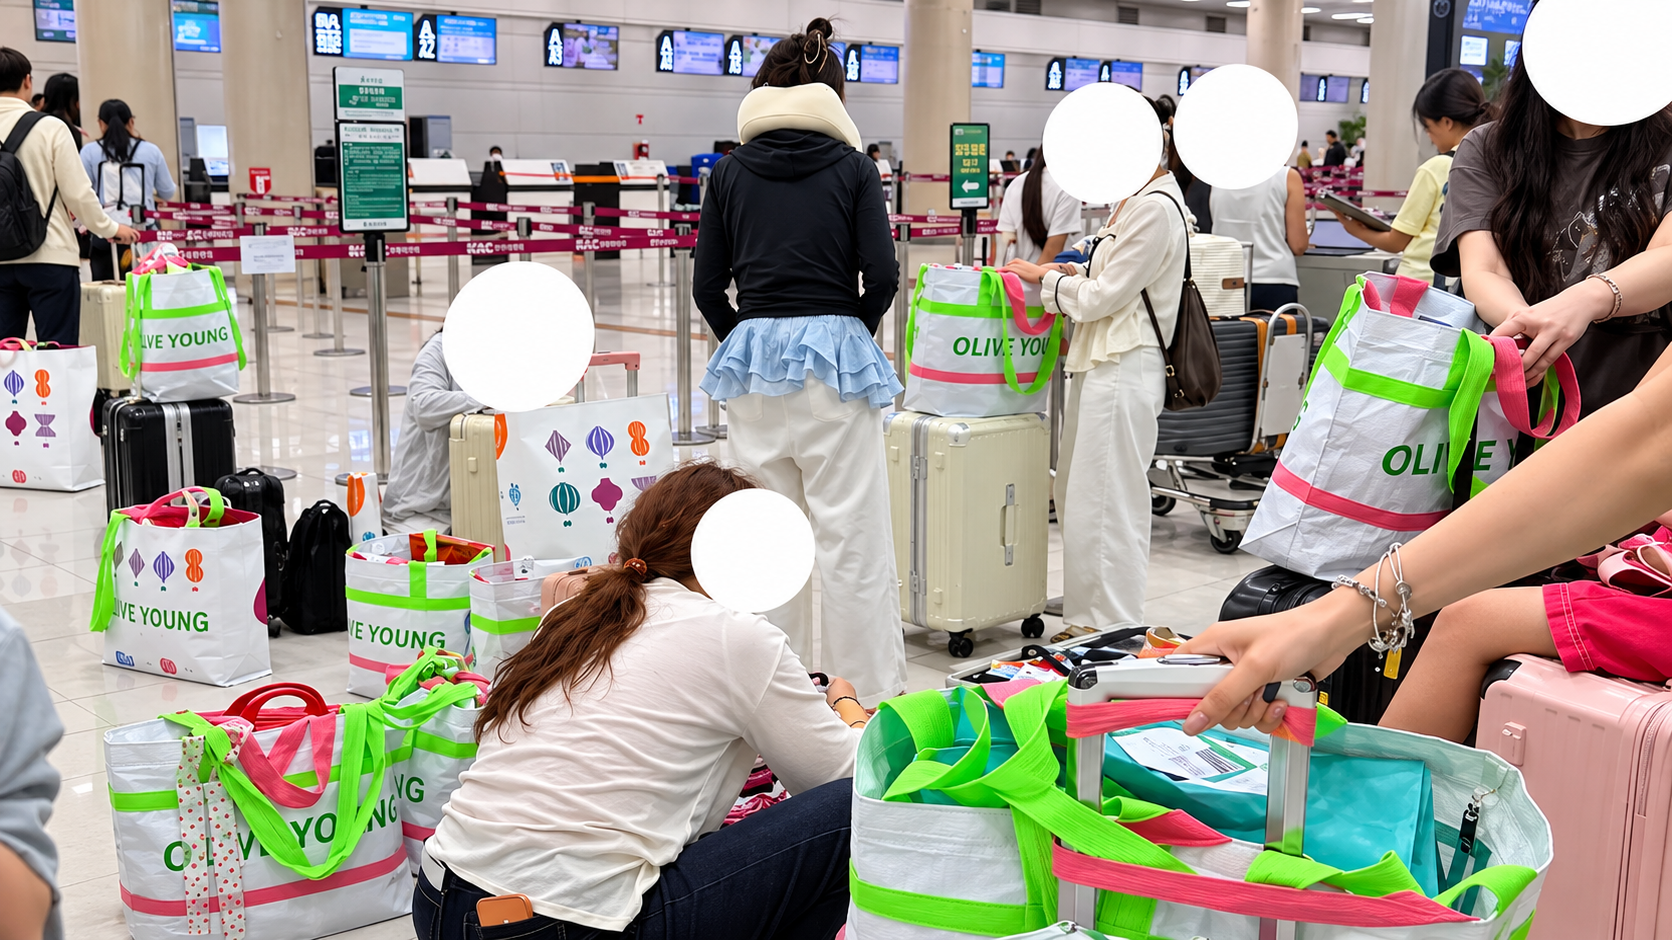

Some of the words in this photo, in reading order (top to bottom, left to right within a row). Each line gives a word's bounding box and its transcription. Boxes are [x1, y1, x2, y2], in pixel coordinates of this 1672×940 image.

[466, 242, 494, 254] KAC
[167, 326, 229, 348] YOUNG
[1020, 336, 1051, 356] YOU
[1381, 439, 1497, 476] OLIE
[139, 605, 209, 632] YOUNG
[368, 624, 446, 649] YOUNG
[289, 794, 397, 849] YONG
